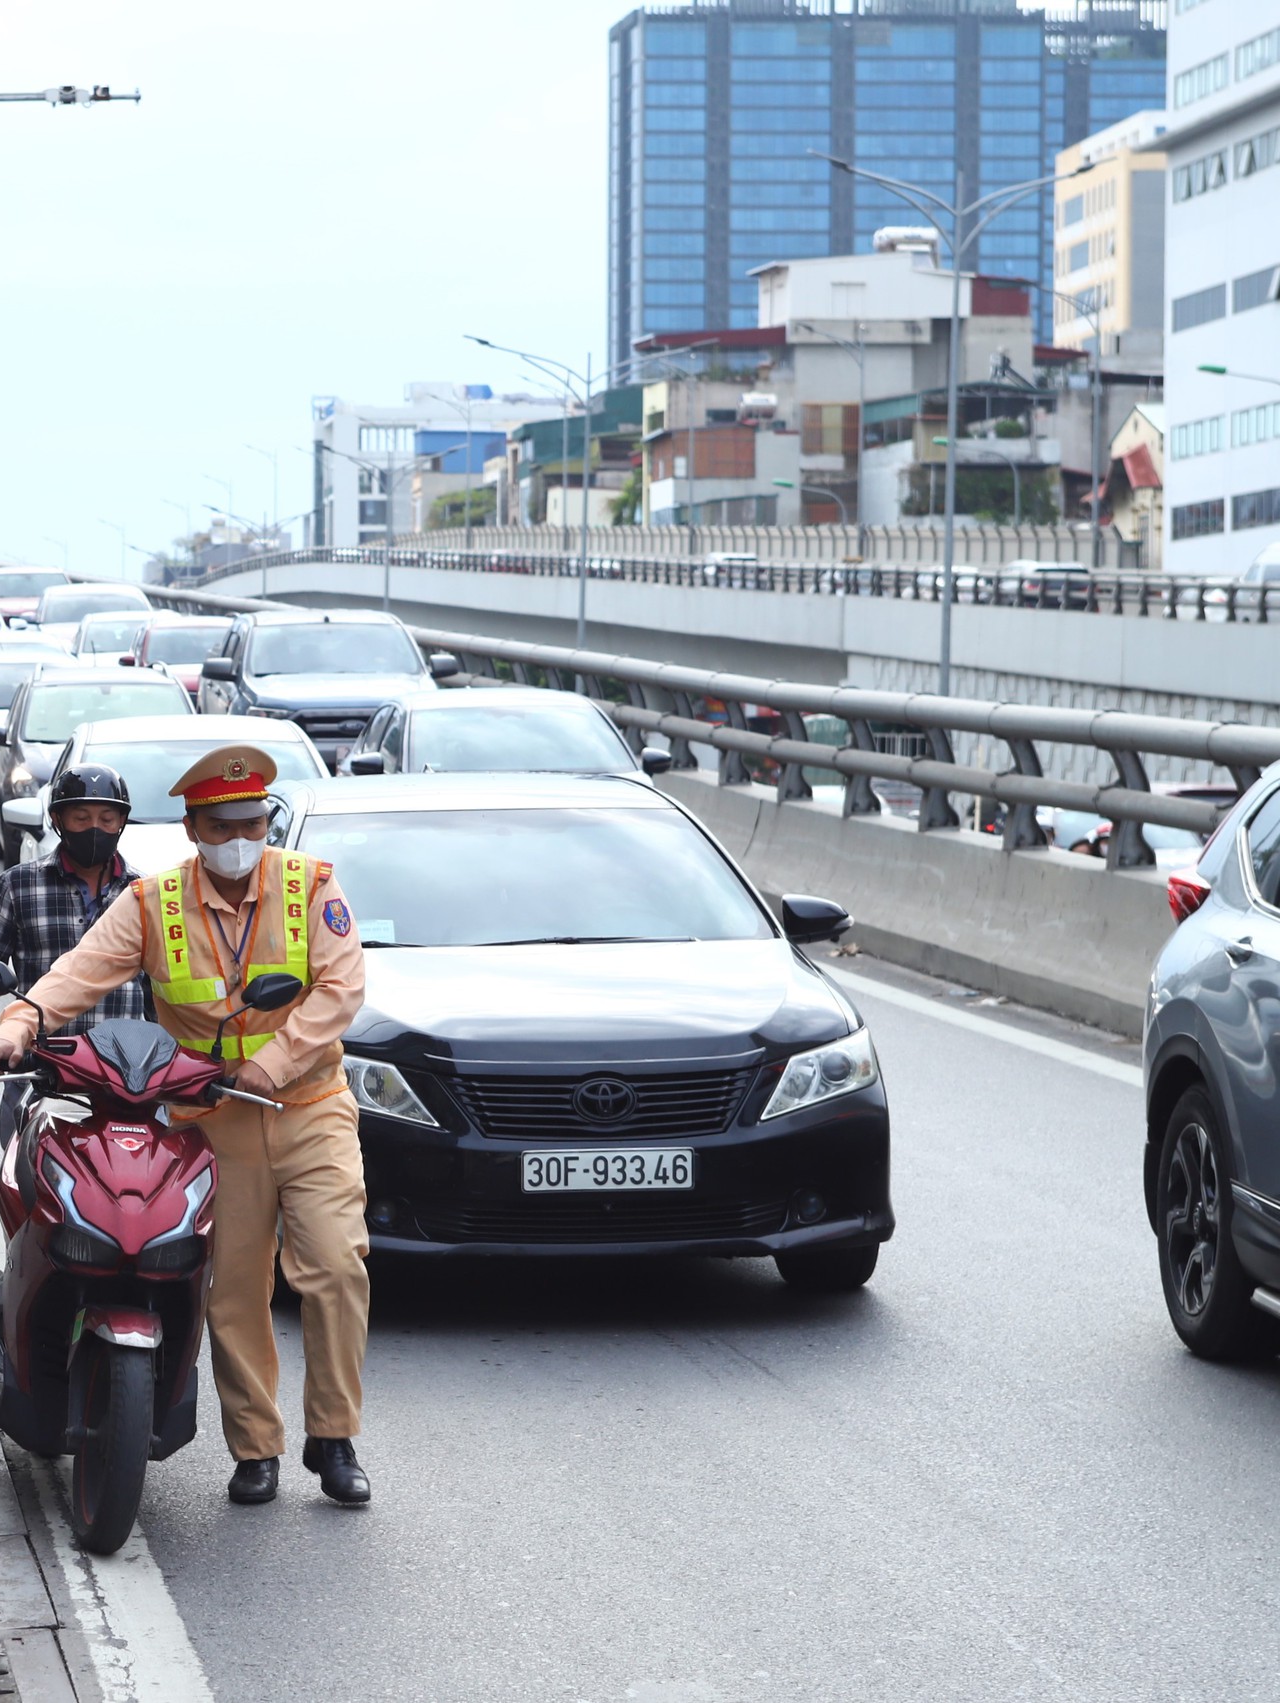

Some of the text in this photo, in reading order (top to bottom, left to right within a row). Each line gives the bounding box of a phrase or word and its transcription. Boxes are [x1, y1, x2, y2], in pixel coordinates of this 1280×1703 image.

[163, 878, 184, 964] CSGT
[285, 859, 302, 942] CSGT
[111, 1126, 147, 1134] HONDA
[527, 1154, 688, 1187] 30F-933.46
